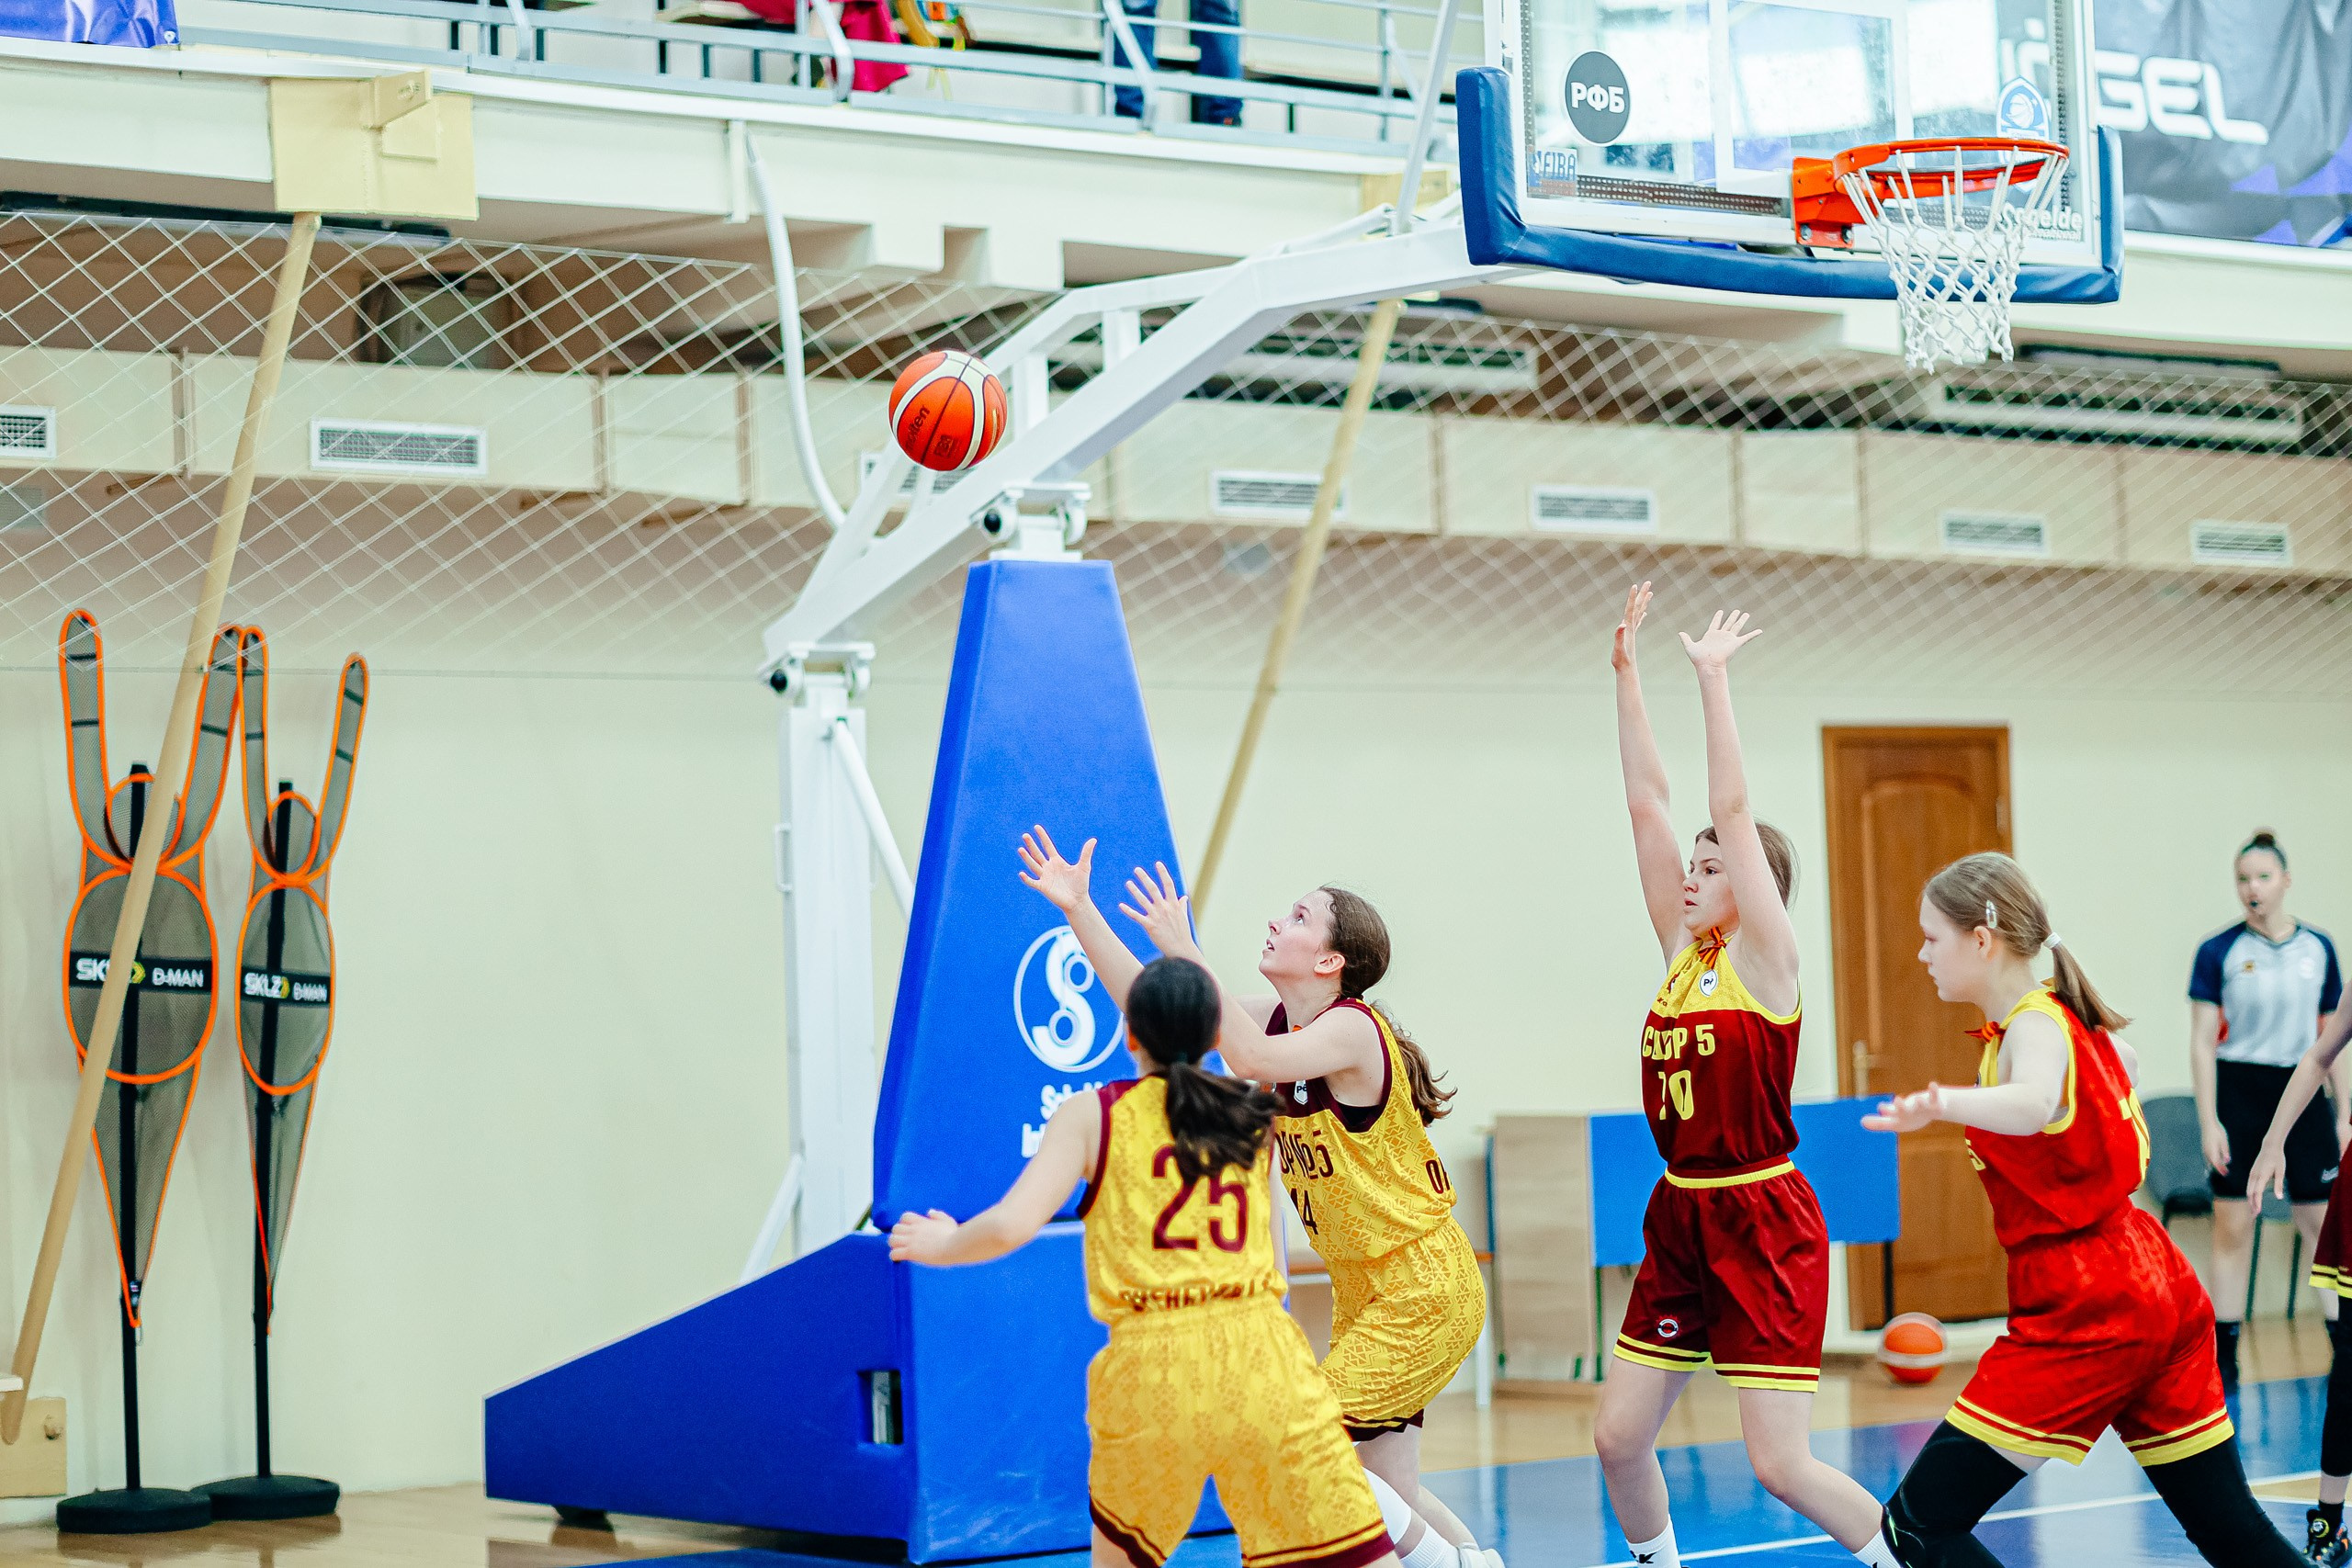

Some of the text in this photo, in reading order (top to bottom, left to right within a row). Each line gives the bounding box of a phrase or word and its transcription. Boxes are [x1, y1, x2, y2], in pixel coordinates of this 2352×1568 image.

[1570, 82, 1625, 114] РФБ
[75, 957, 204, 987] SK D-MAN
[243, 972, 328, 1002] SKLZ D-MAN
[1695, 1024, 1715, 1056] 5
[1657, 1069, 1694, 1121] 10
[1152, 1144, 1248, 1254] 25
